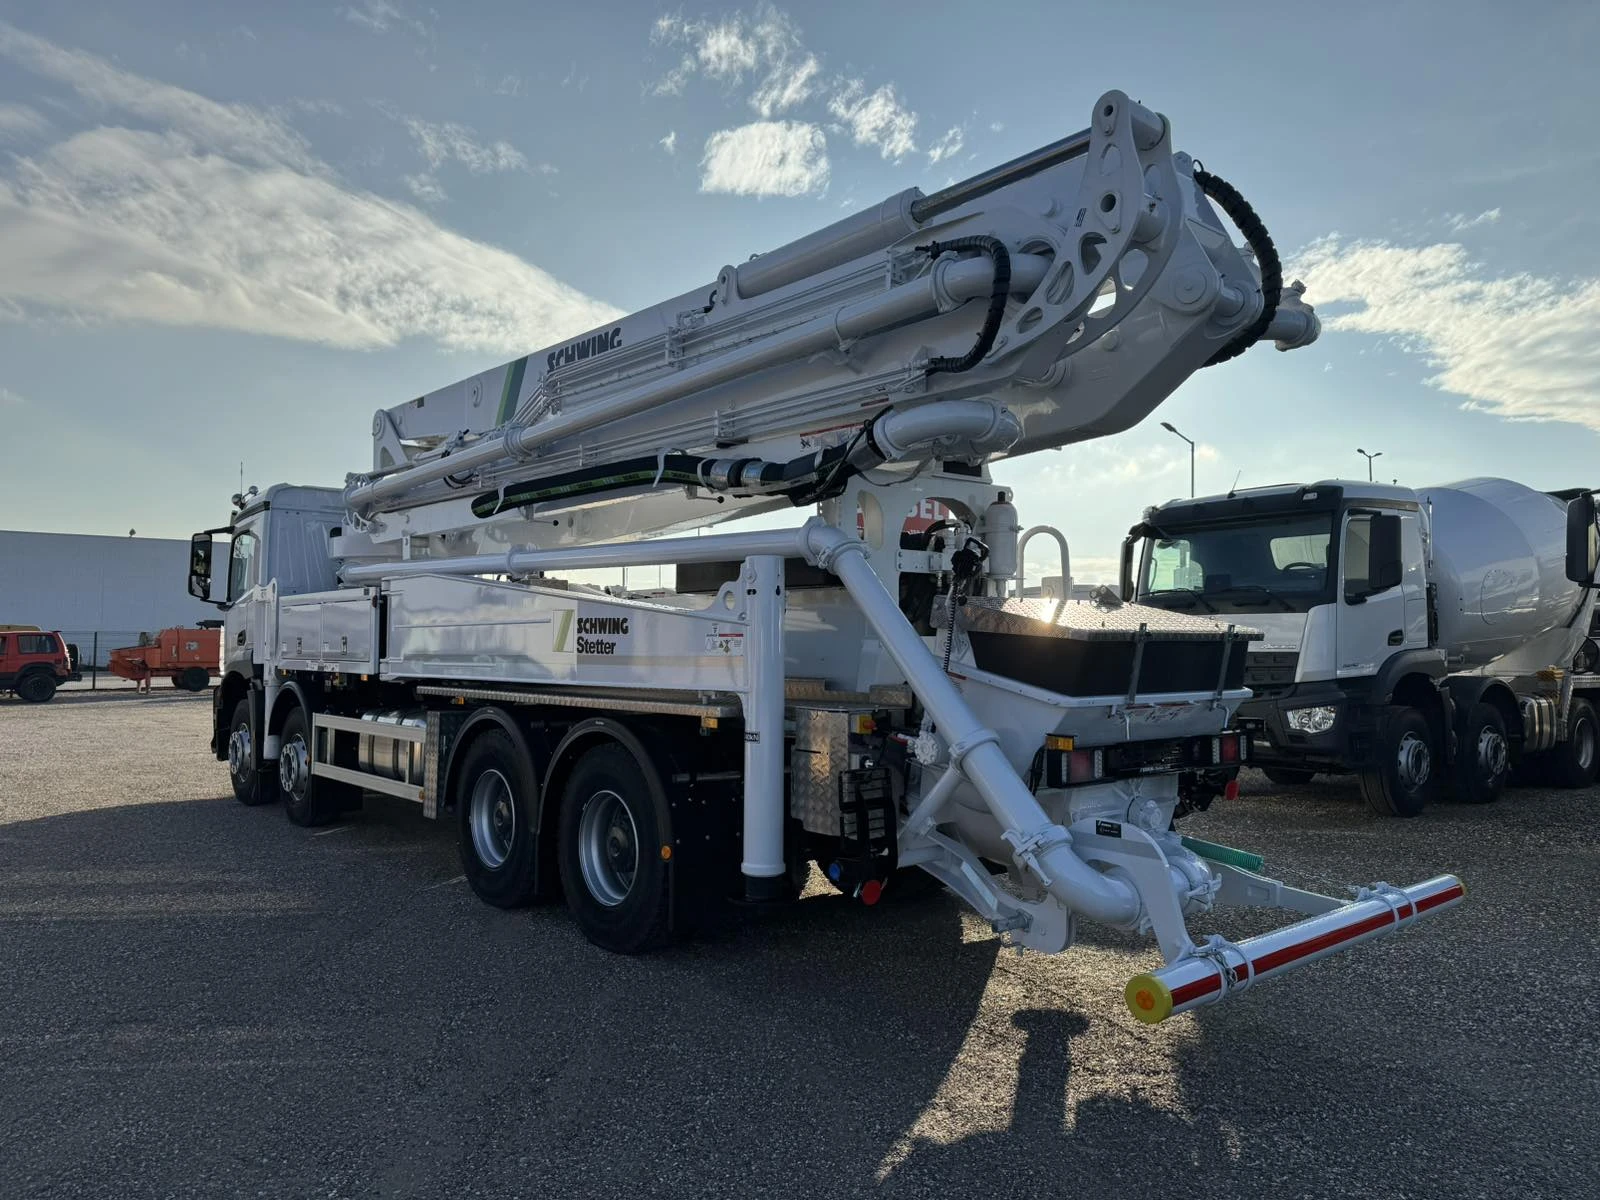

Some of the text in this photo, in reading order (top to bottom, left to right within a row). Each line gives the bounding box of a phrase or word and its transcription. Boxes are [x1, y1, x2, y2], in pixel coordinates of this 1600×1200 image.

[547, 327, 622, 374] SCHWING
[577, 617, 629, 635] SCHWING
[577, 636, 617, 654] Stetter
